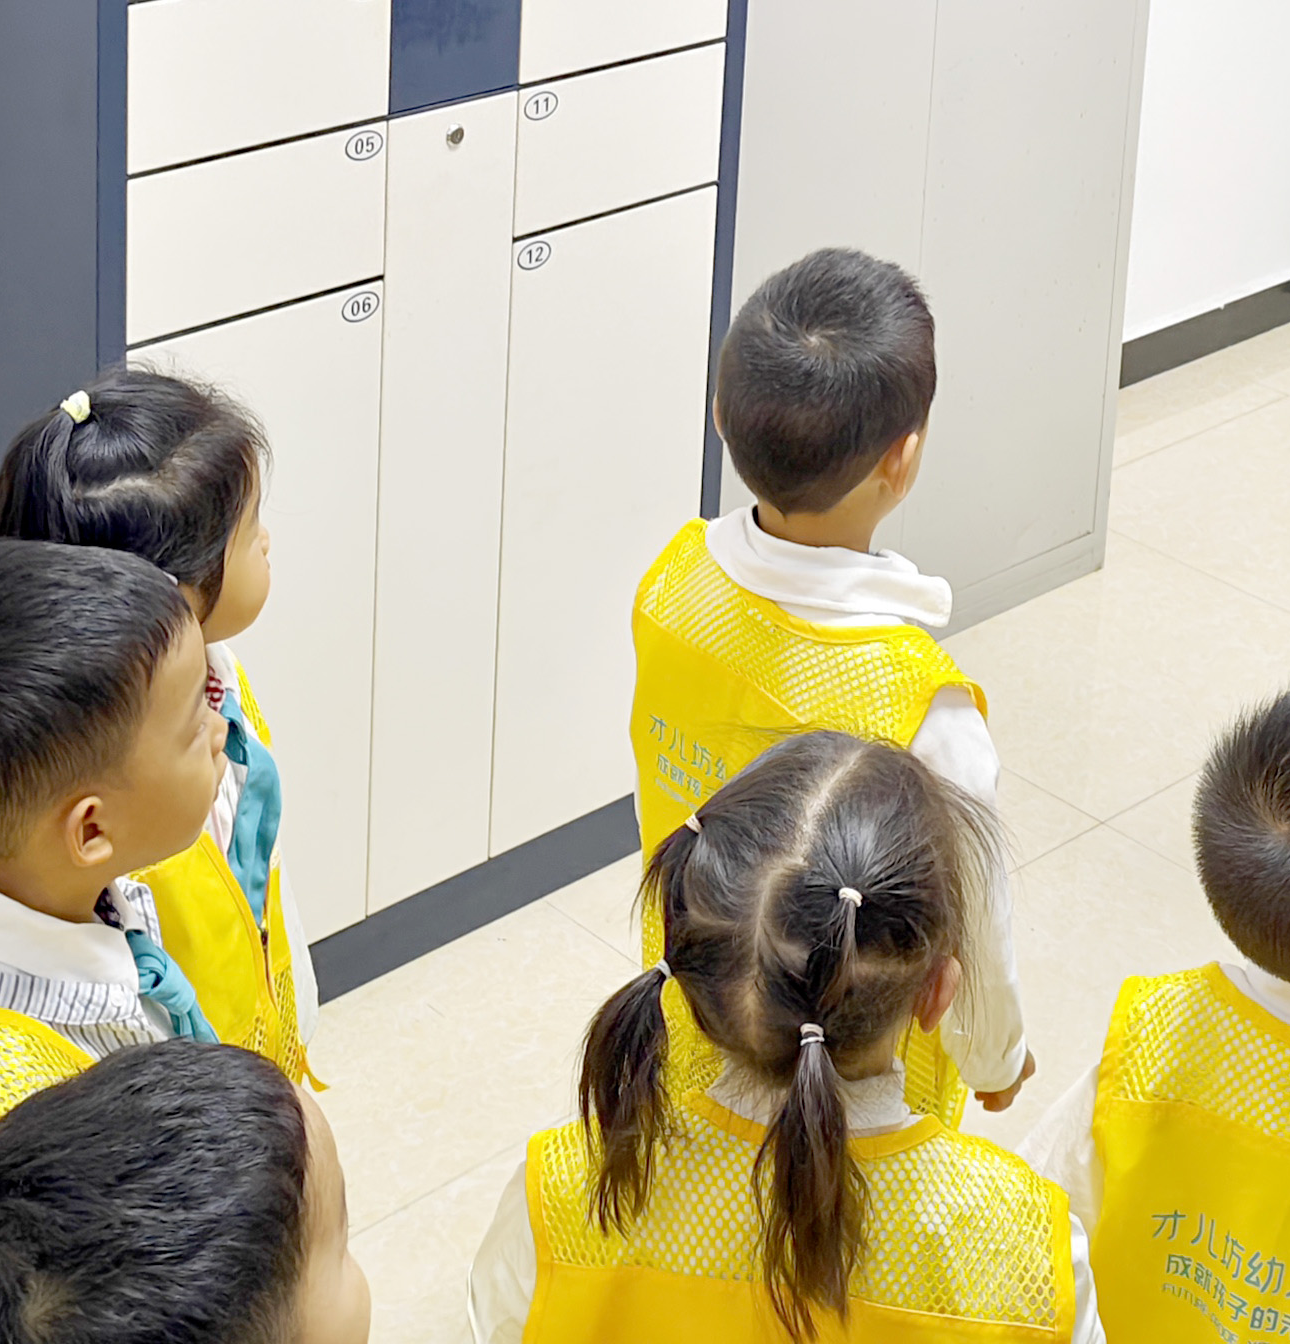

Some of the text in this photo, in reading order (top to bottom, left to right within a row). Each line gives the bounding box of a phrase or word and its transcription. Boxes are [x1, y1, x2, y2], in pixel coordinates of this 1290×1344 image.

[532, 96, 551, 115] 11
[354, 136, 375, 155] 05
[525, 247, 545, 265] 12
[350, 297, 372, 316] 06
